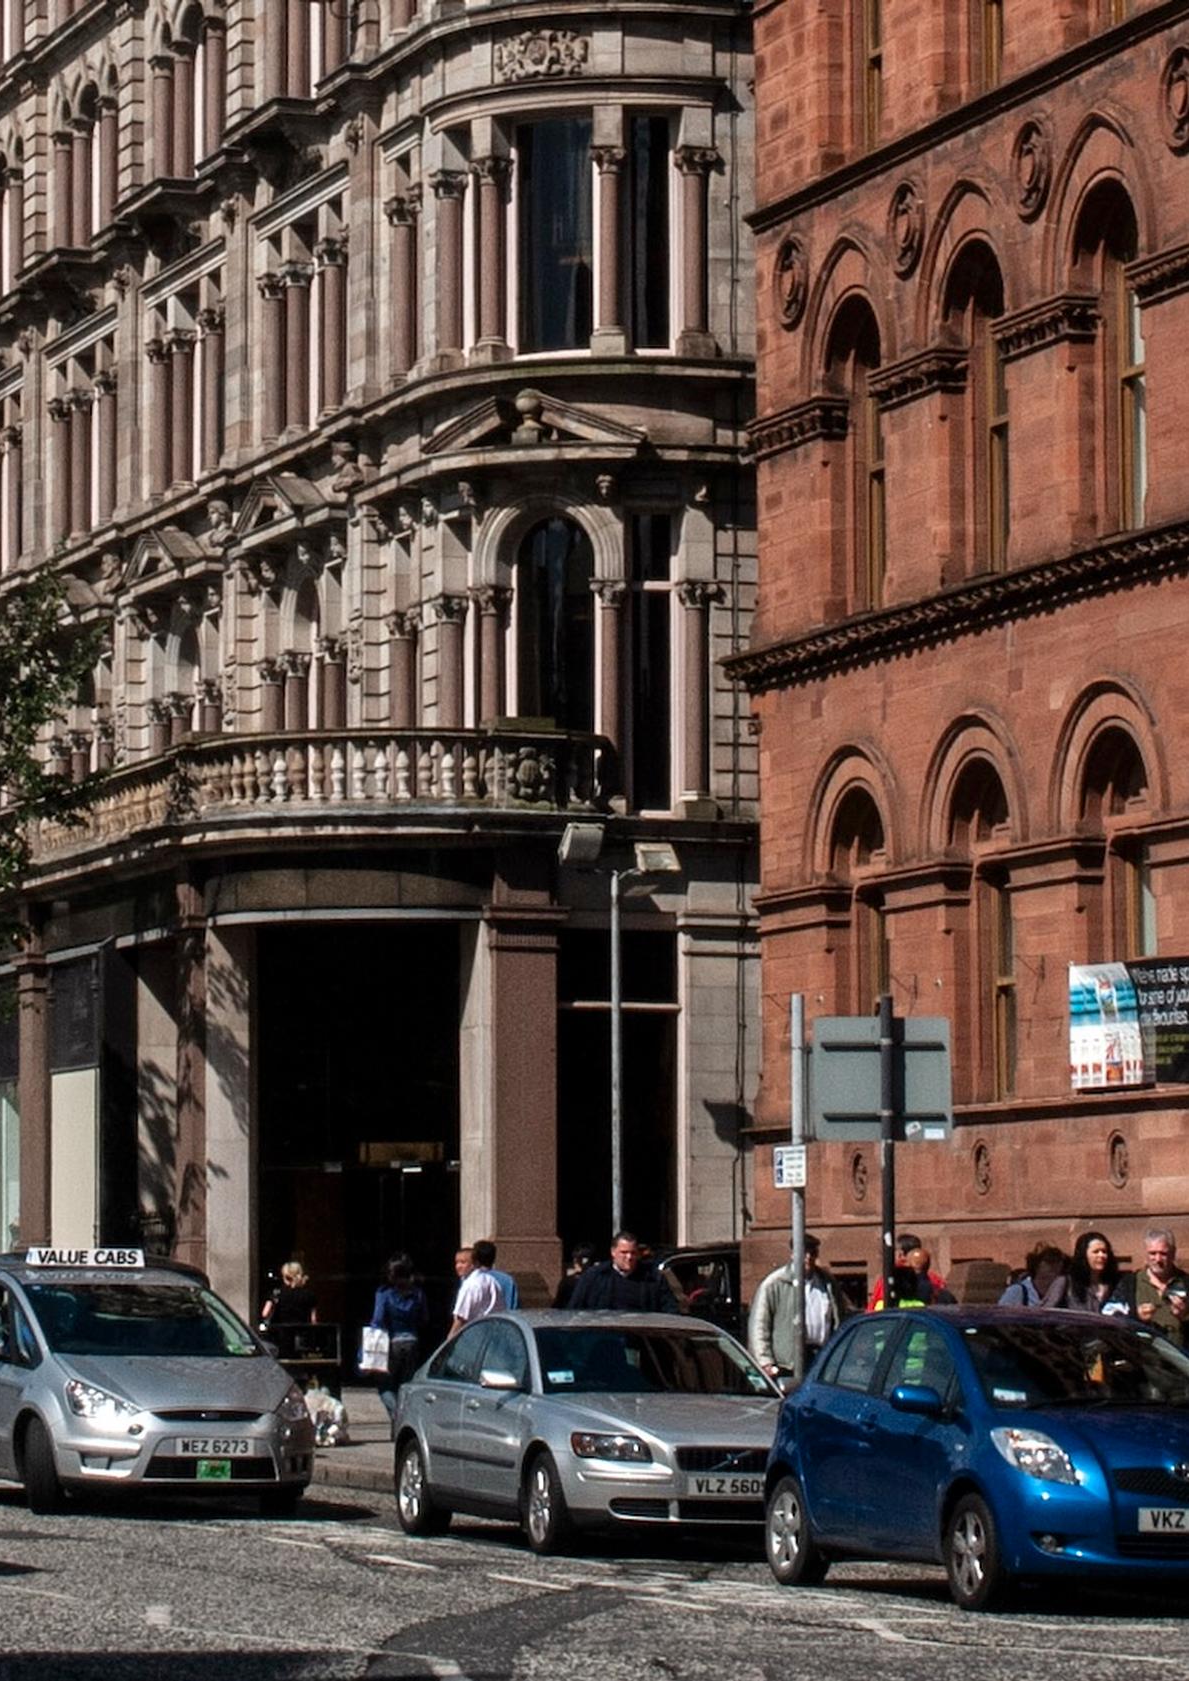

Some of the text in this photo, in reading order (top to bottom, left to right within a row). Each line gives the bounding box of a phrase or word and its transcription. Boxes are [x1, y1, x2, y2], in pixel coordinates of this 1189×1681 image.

[37, 1250, 138, 1265] VALUE CABS
[181, 1440, 249, 1454] WEZ 6273
[695, 1479, 726, 1494] VLZ
[1150, 1510, 1186, 1529] VKZ
